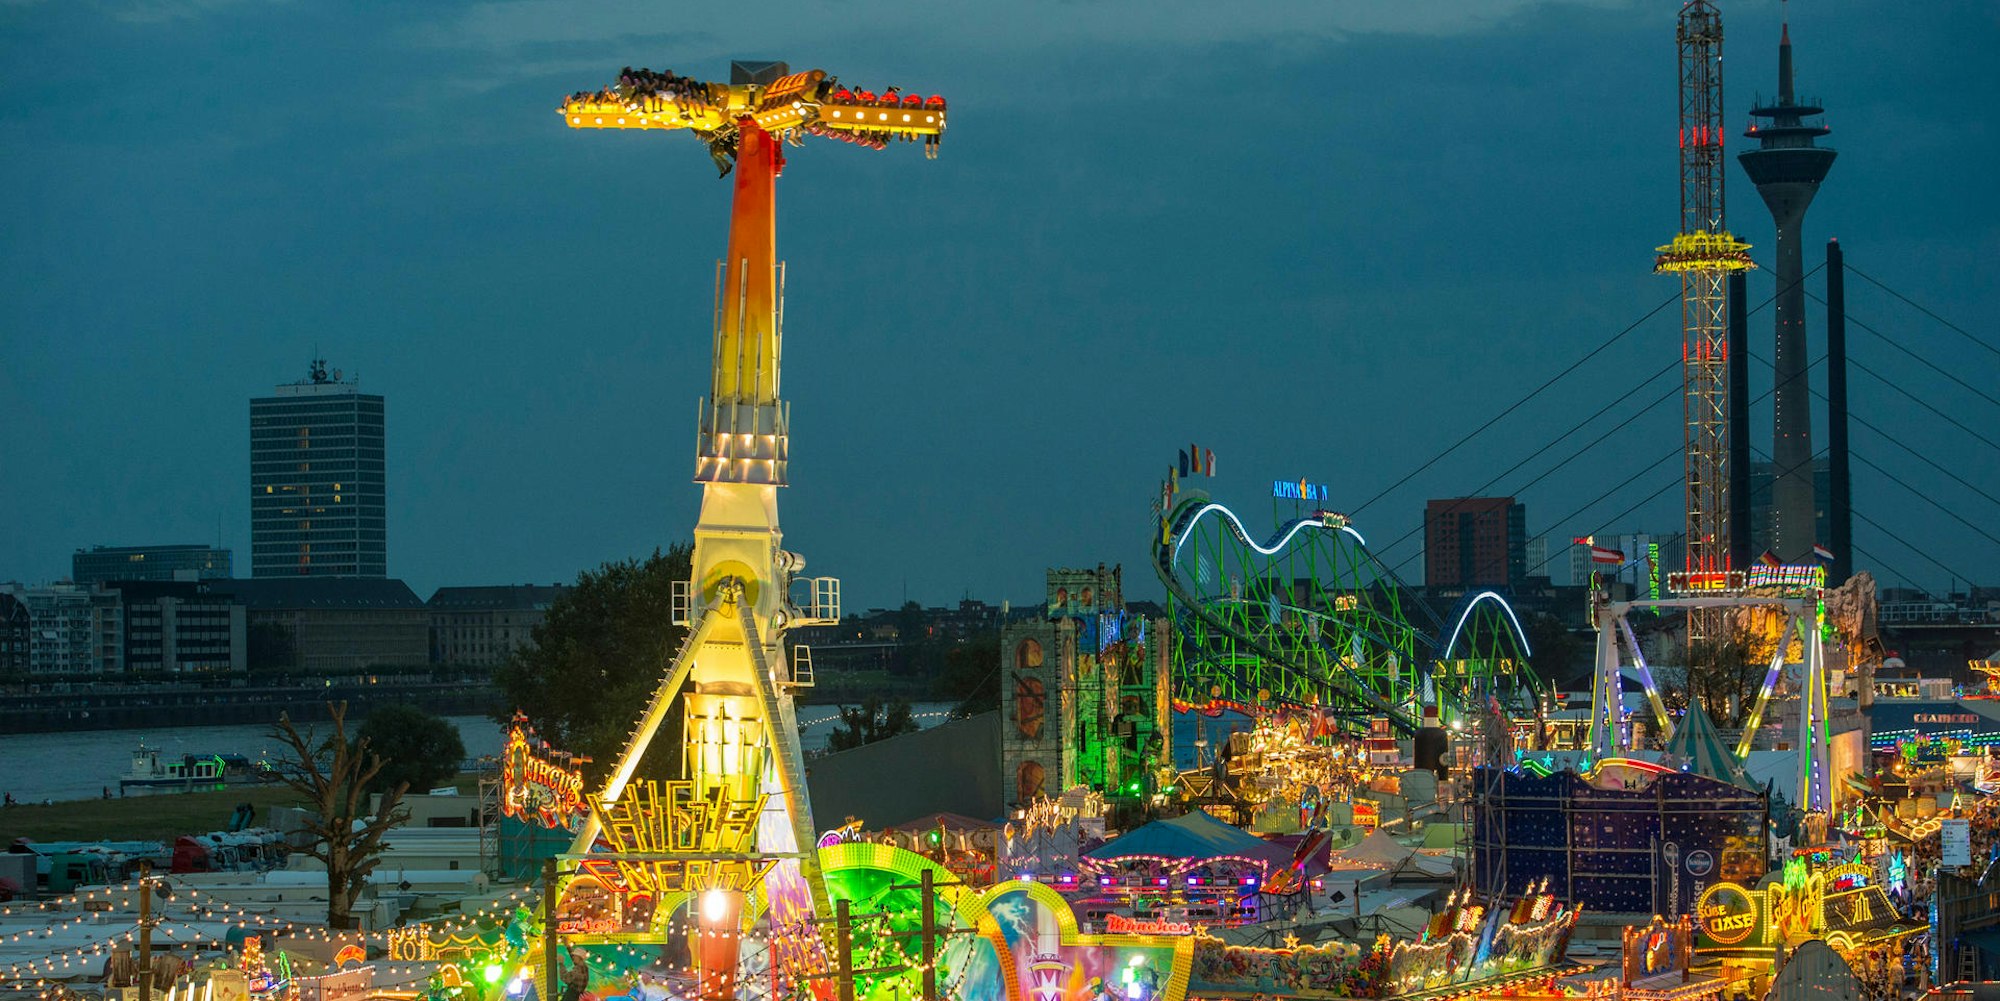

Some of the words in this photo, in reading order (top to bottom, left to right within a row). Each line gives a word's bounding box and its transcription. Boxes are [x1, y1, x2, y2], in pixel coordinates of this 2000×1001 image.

[1273, 480, 1301, 499] ALPINA
[1306, 483, 1328, 501] BAN
[1670, 572, 1744, 591] MAIER
[527, 756, 584, 807] CIRCUS
[585, 780, 770, 853] HIGH
[579, 859, 780, 892] ENERGY
[1104, 913, 1193, 934] München
[1710, 912, 1753, 933] OASE
